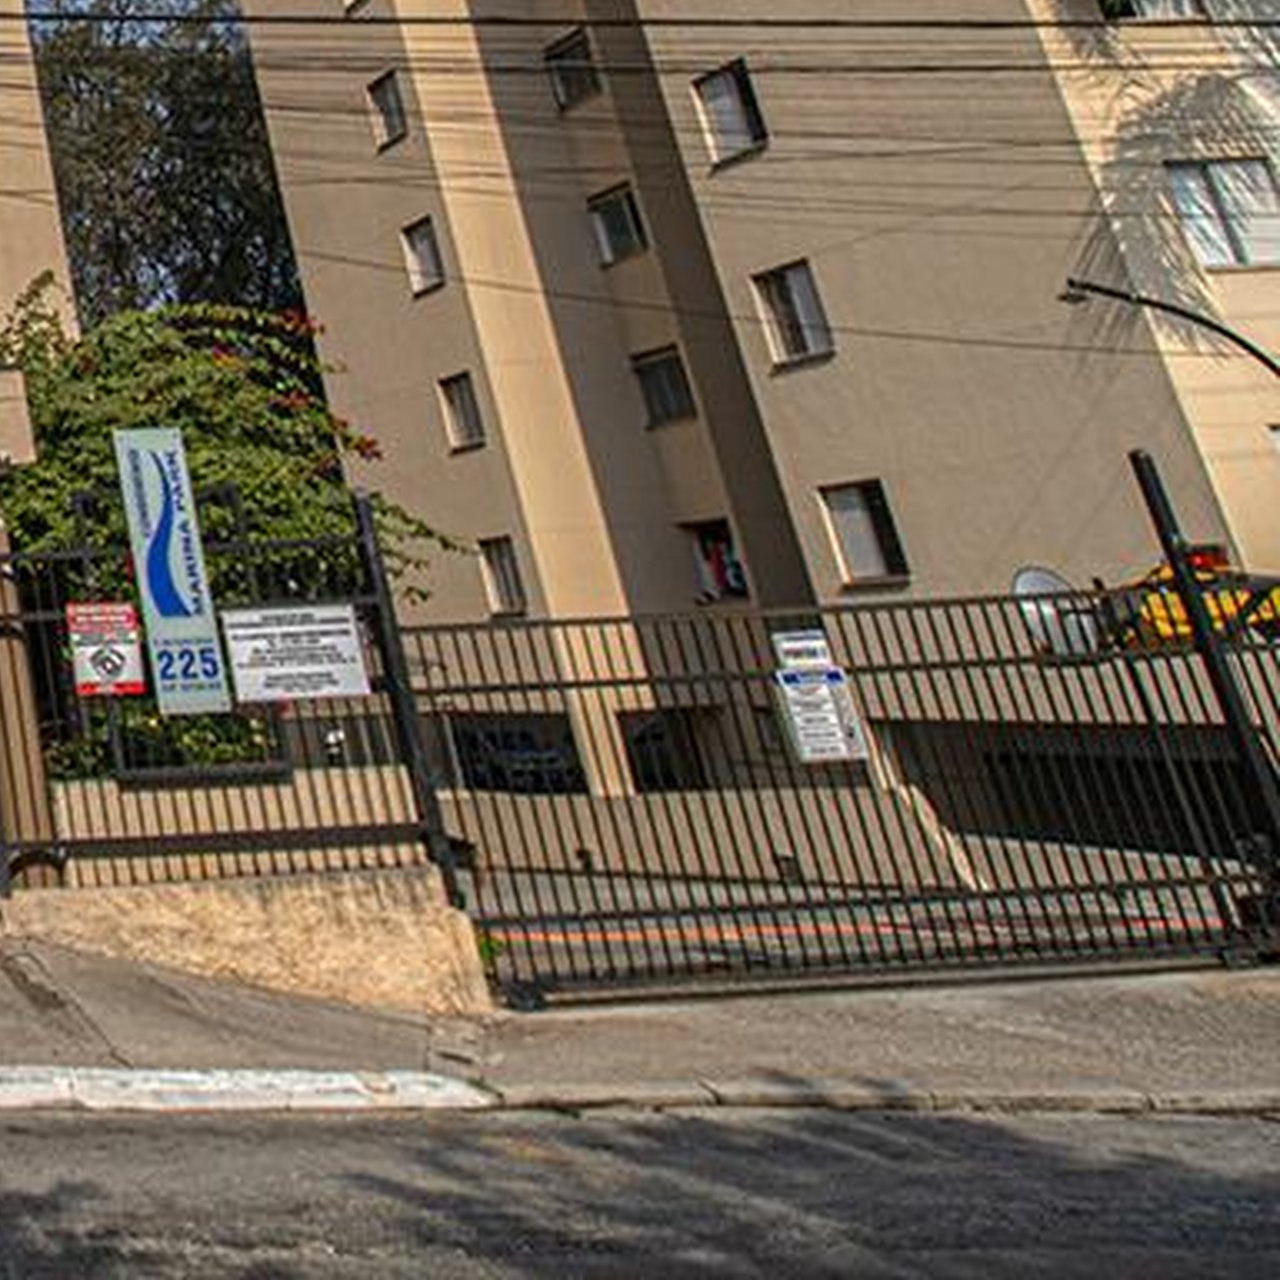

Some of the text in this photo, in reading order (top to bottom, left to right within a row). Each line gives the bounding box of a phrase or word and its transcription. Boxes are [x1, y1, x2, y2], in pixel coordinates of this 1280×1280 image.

[164, 449, 205, 616] MARINA PARK
[157, 647, 219, 680] 225
